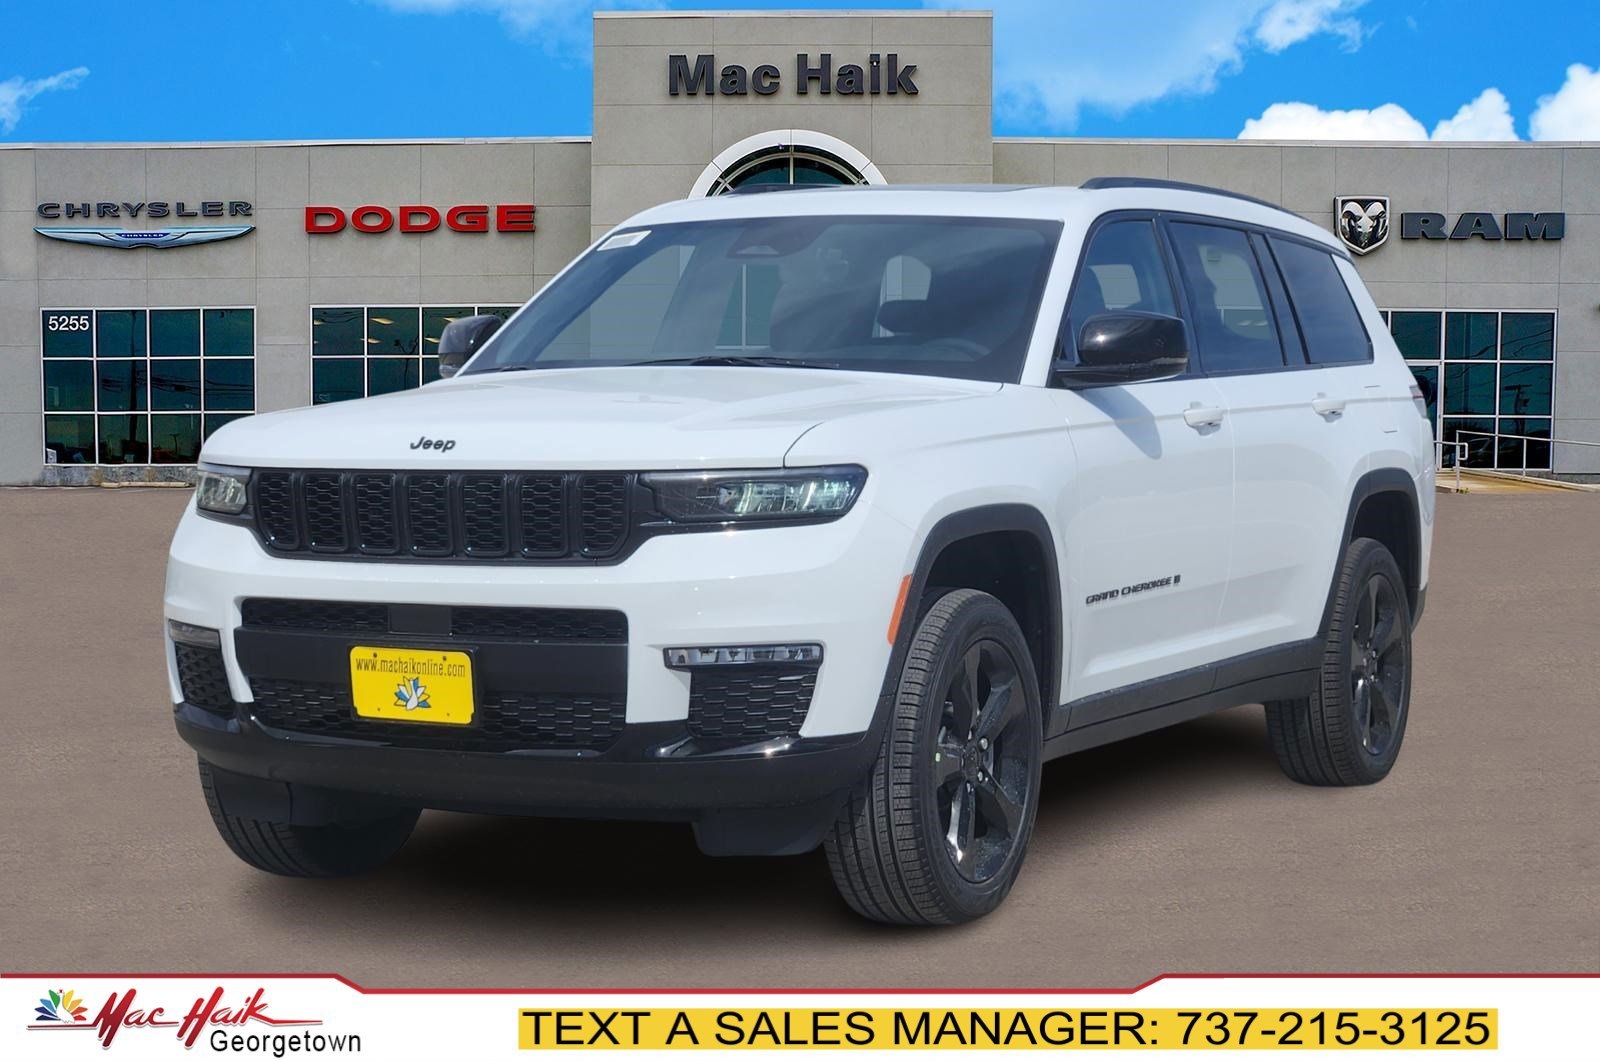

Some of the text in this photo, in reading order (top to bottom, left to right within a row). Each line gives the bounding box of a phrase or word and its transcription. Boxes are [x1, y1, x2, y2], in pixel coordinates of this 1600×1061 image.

[668, 53, 919, 96] Mac Haik
[37, 200, 253, 218] CHRYSLER
[305, 204, 536, 234] DODGE
[1401, 212, 1566, 240] RAM
[47, 315, 90, 332] 5255
[410, 436, 456, 453] Jeep
[1085, 589, 1119, 604] GRAND
[1121, 576, 1172, 596] CHEROKEE
[355, 656, 466, 678] www.machaikonline.com
